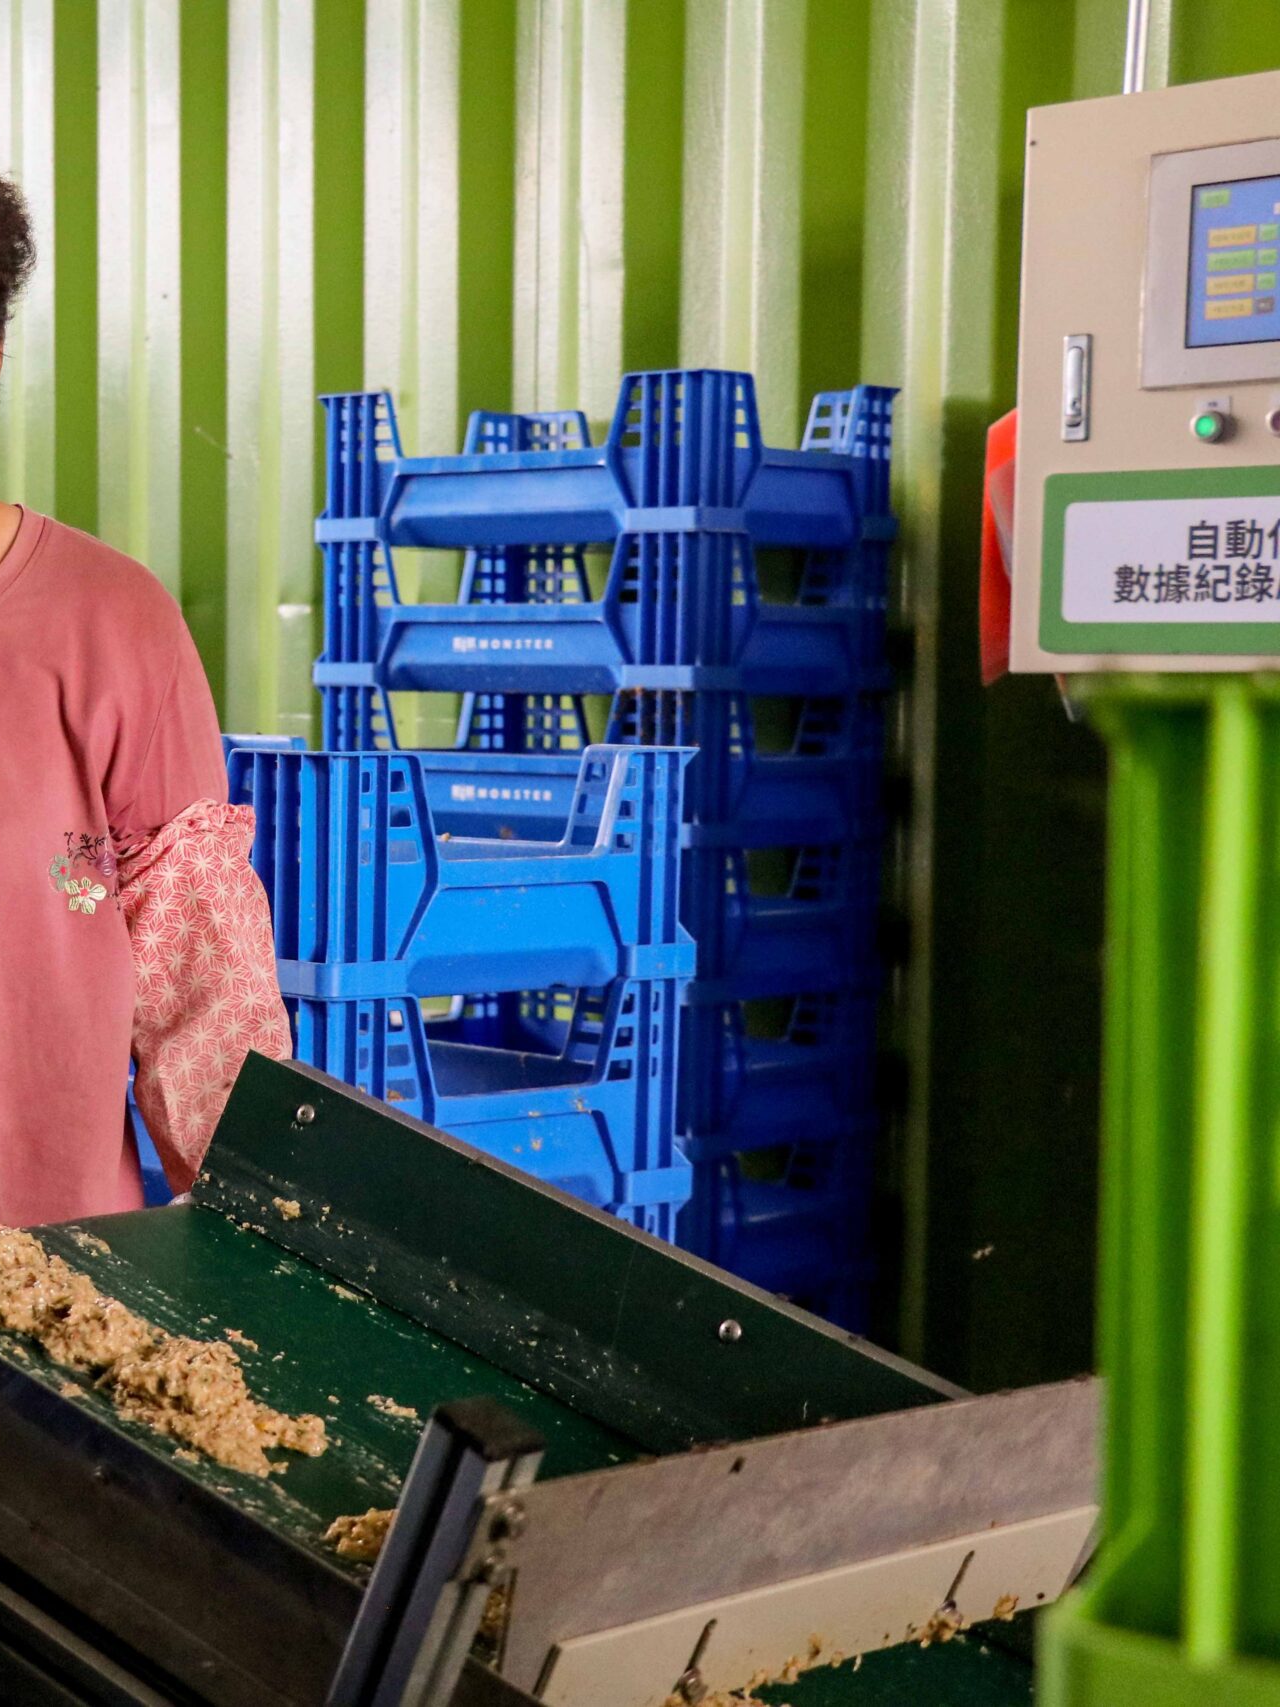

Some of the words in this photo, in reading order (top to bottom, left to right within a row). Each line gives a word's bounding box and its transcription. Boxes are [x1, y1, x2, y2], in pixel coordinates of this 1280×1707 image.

[1114, 562, 1280, 603] 數據紀錄
[479, 638, 553, 650] MONSTER
[477, 787, 552, 801] MONSTER
